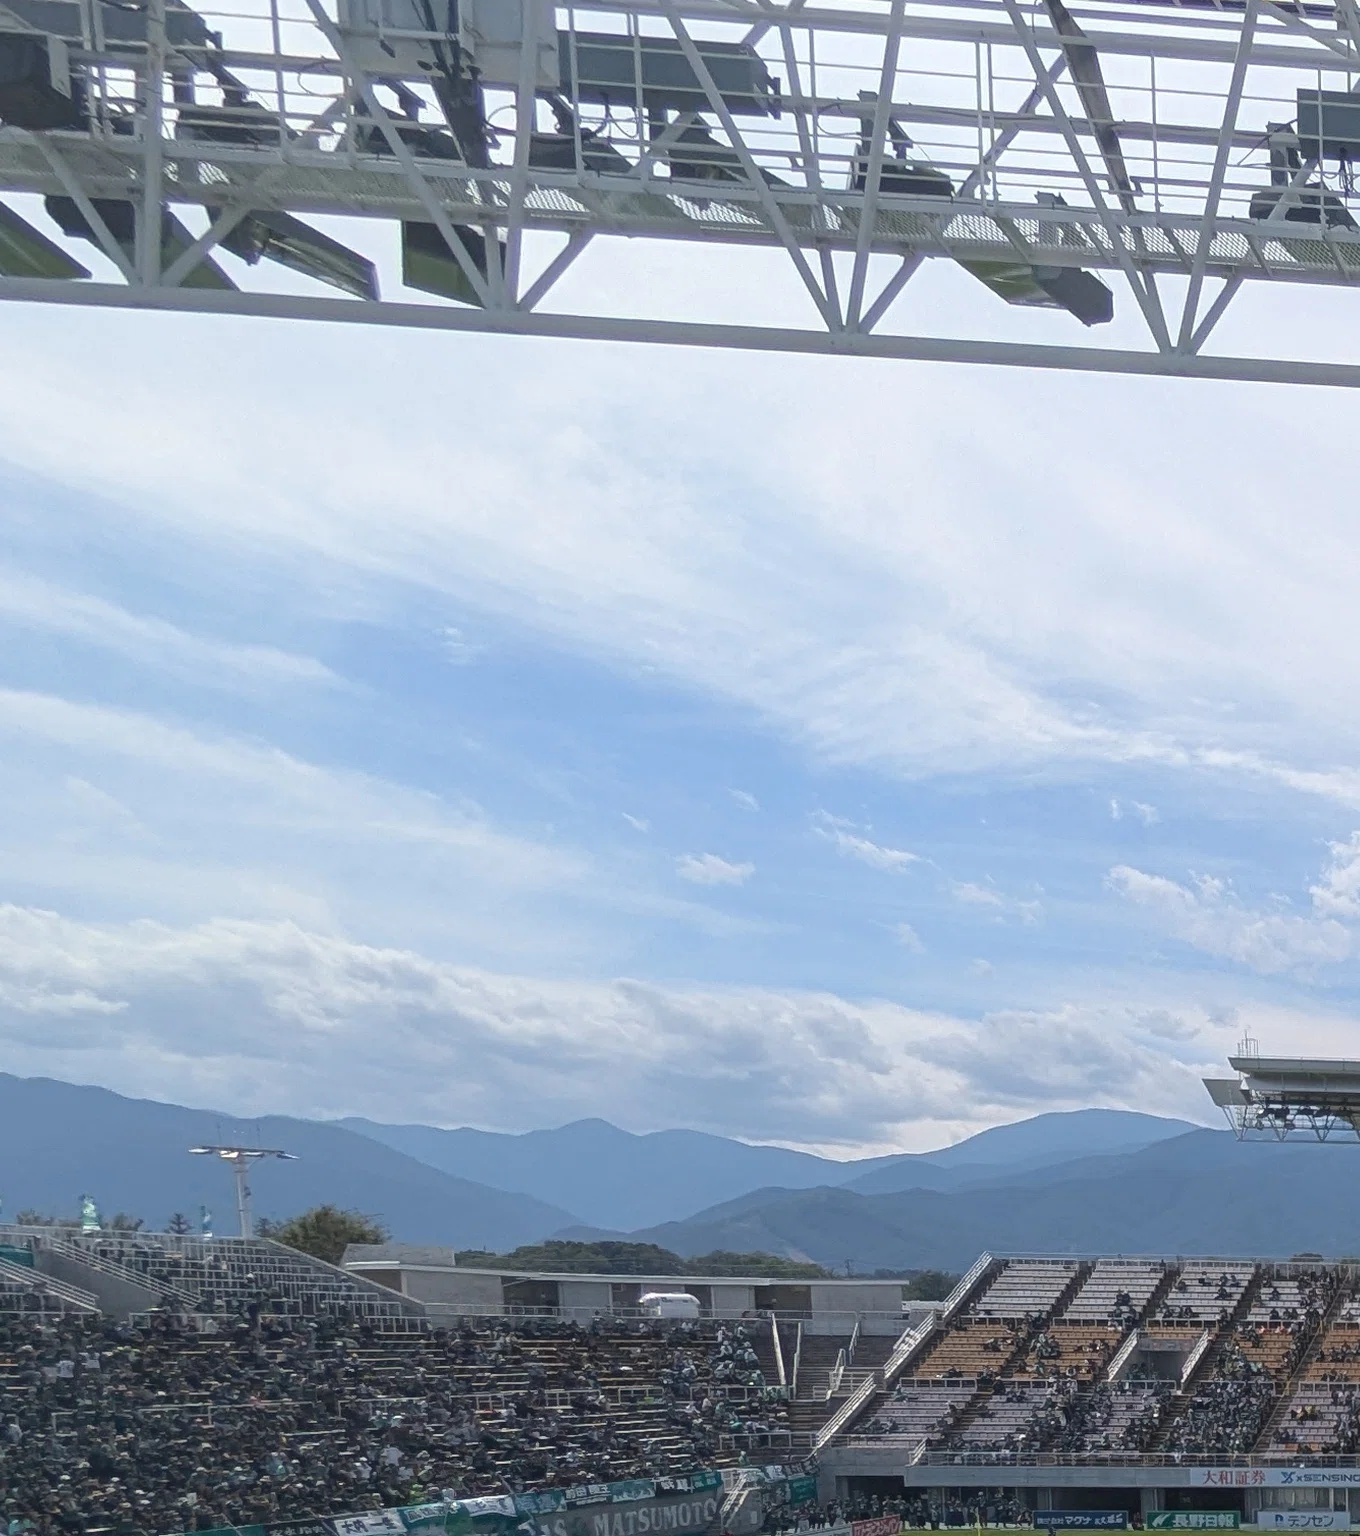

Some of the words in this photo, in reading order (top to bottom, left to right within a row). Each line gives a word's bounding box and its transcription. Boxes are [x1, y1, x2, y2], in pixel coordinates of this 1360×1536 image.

[1203, 1470, 1266, 1485] 大和証券
[1173, 1514, 1235, 1528] 長野日報
